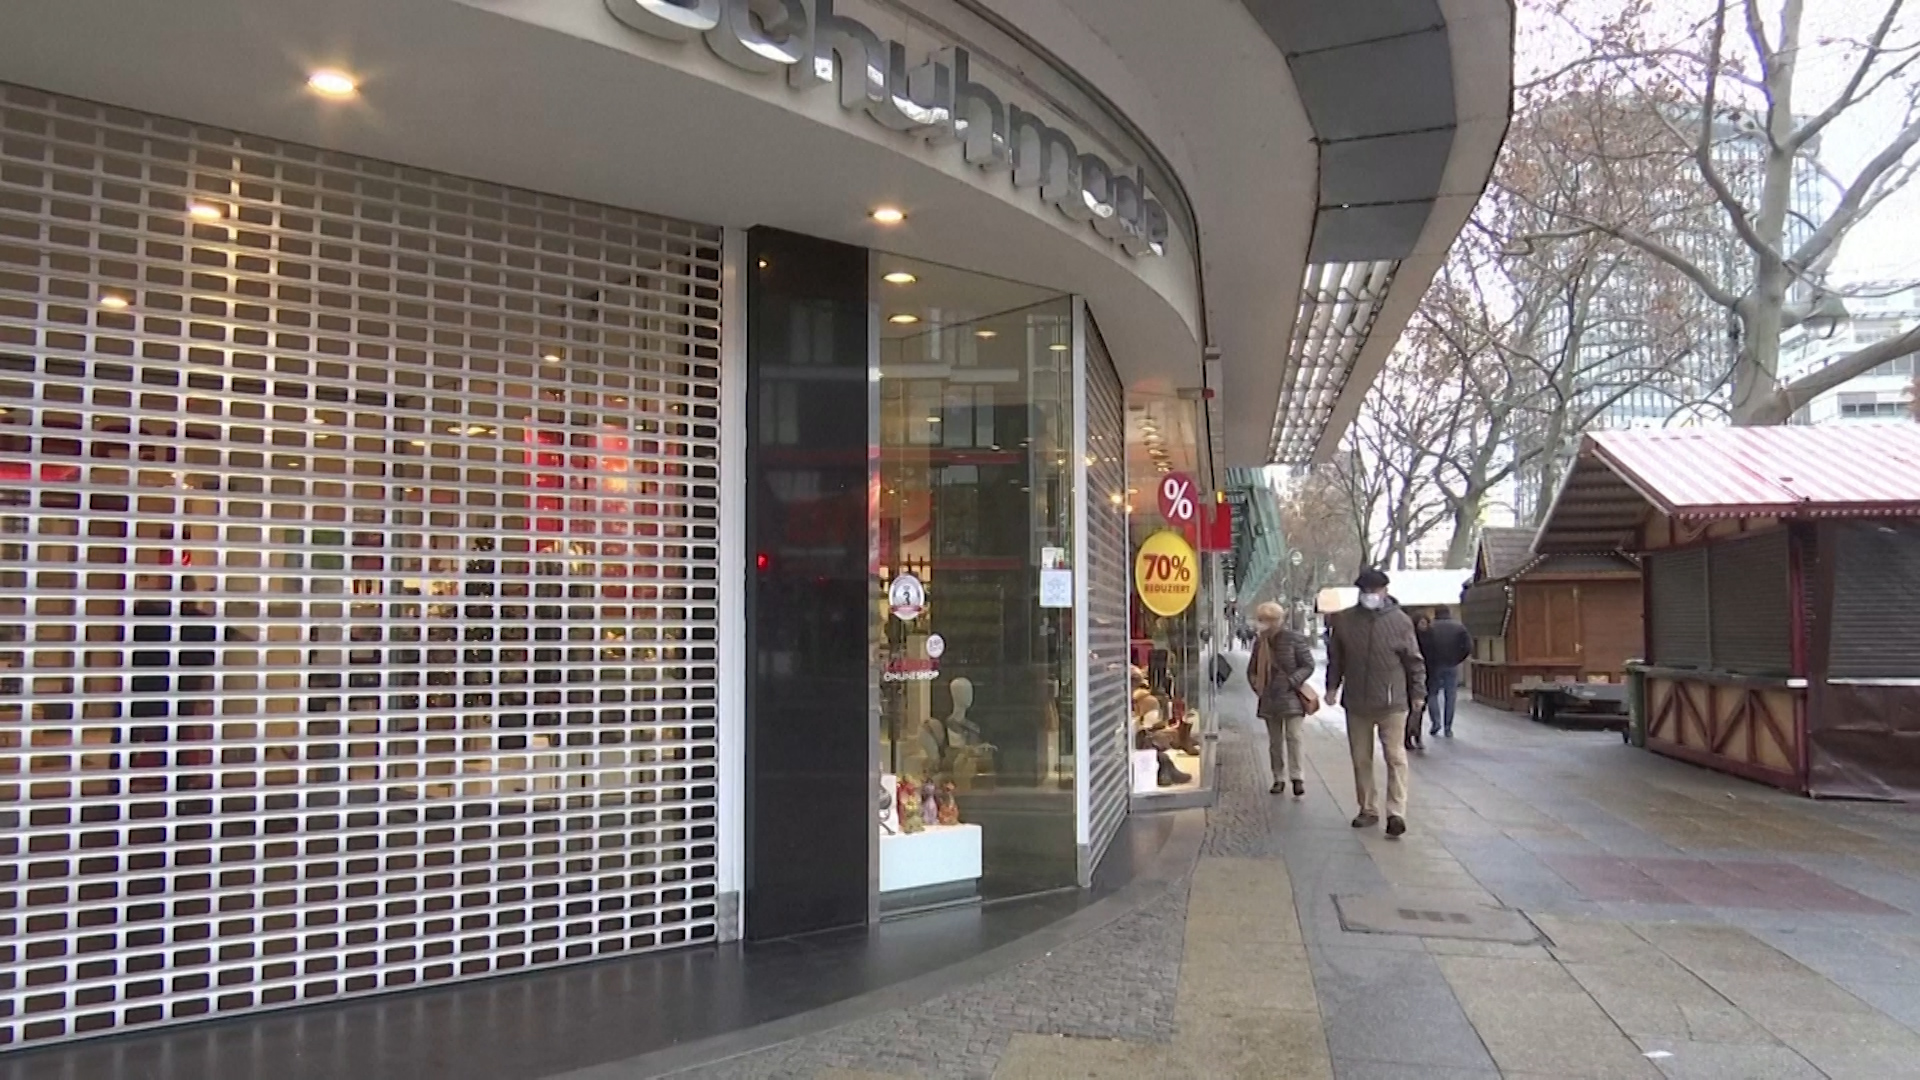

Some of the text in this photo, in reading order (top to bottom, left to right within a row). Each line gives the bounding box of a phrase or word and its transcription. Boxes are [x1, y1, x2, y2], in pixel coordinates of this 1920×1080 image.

[1164, 478, 1193, 520] %
[1143, 553, 1191, 582] 70%
[1144, 583, 1190, 594] REDUZIERT
